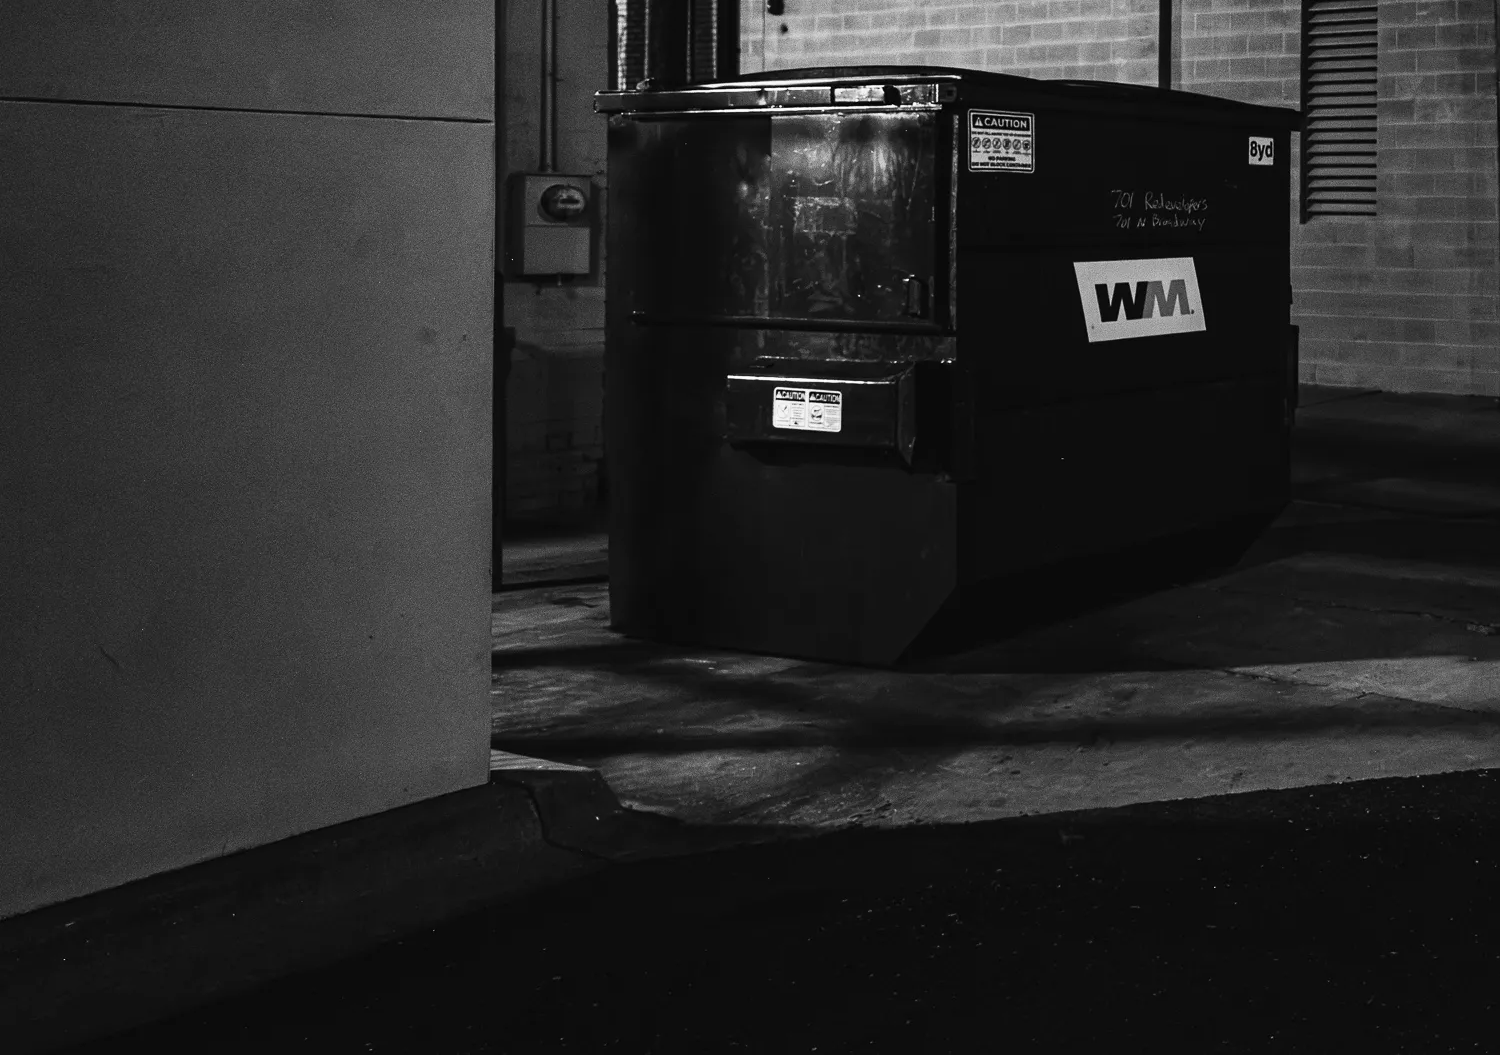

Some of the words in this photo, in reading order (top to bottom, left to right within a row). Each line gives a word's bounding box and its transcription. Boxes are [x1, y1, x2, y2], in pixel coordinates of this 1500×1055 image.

[984, 117, 1027, 128] CAUTION
[1250, 140, 1273, 162] 8yd
[1111, 189, 1134, 209] 701
[1112, 214, 1131, 229] 701
[1094, 278, 1191, 323] WM
[782, 391, 805, 400] CAUTION
[816, 393, 840, 403] CAUTION
